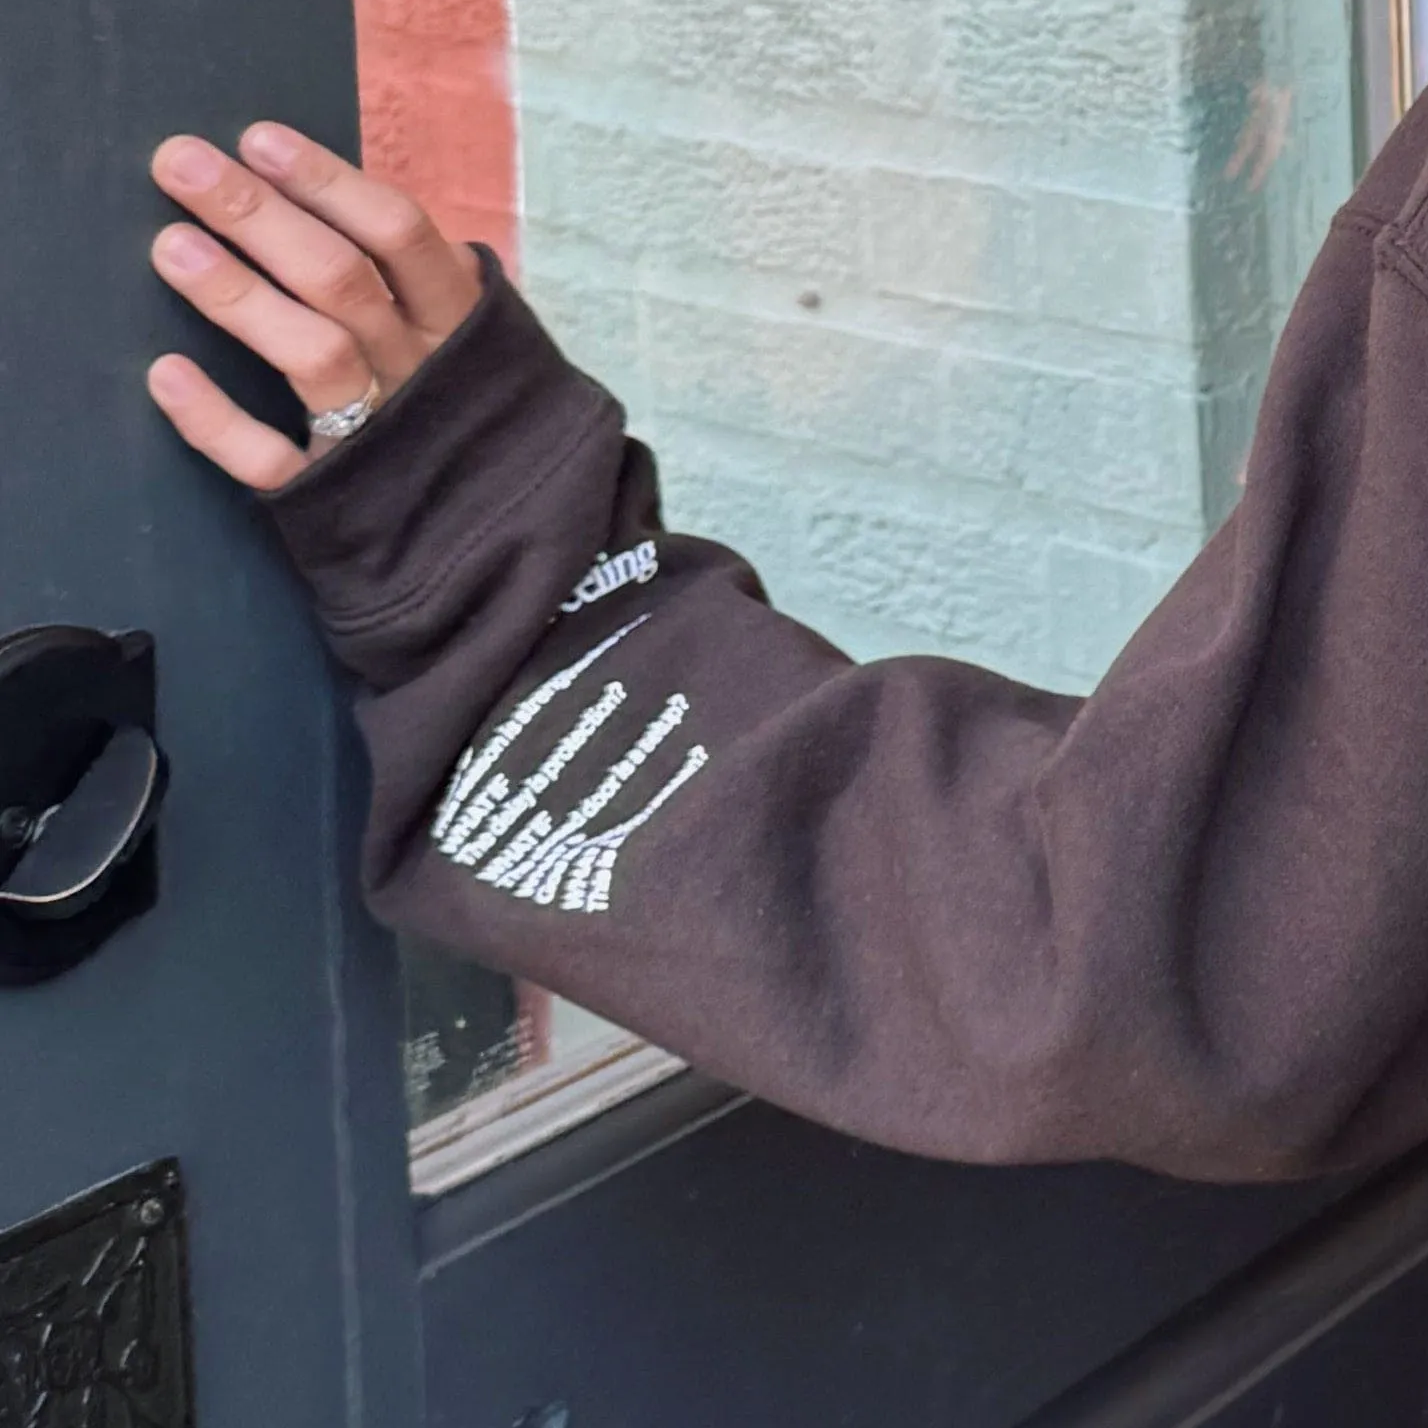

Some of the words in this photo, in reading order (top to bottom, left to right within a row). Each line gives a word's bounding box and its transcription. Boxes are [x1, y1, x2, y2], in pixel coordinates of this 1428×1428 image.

[539, 681, 628, 782] protection?
[438, 791, 496, 856] WHAT
[579, 773, 622, 820] door
[475, 827, 539, 883] WHAT
